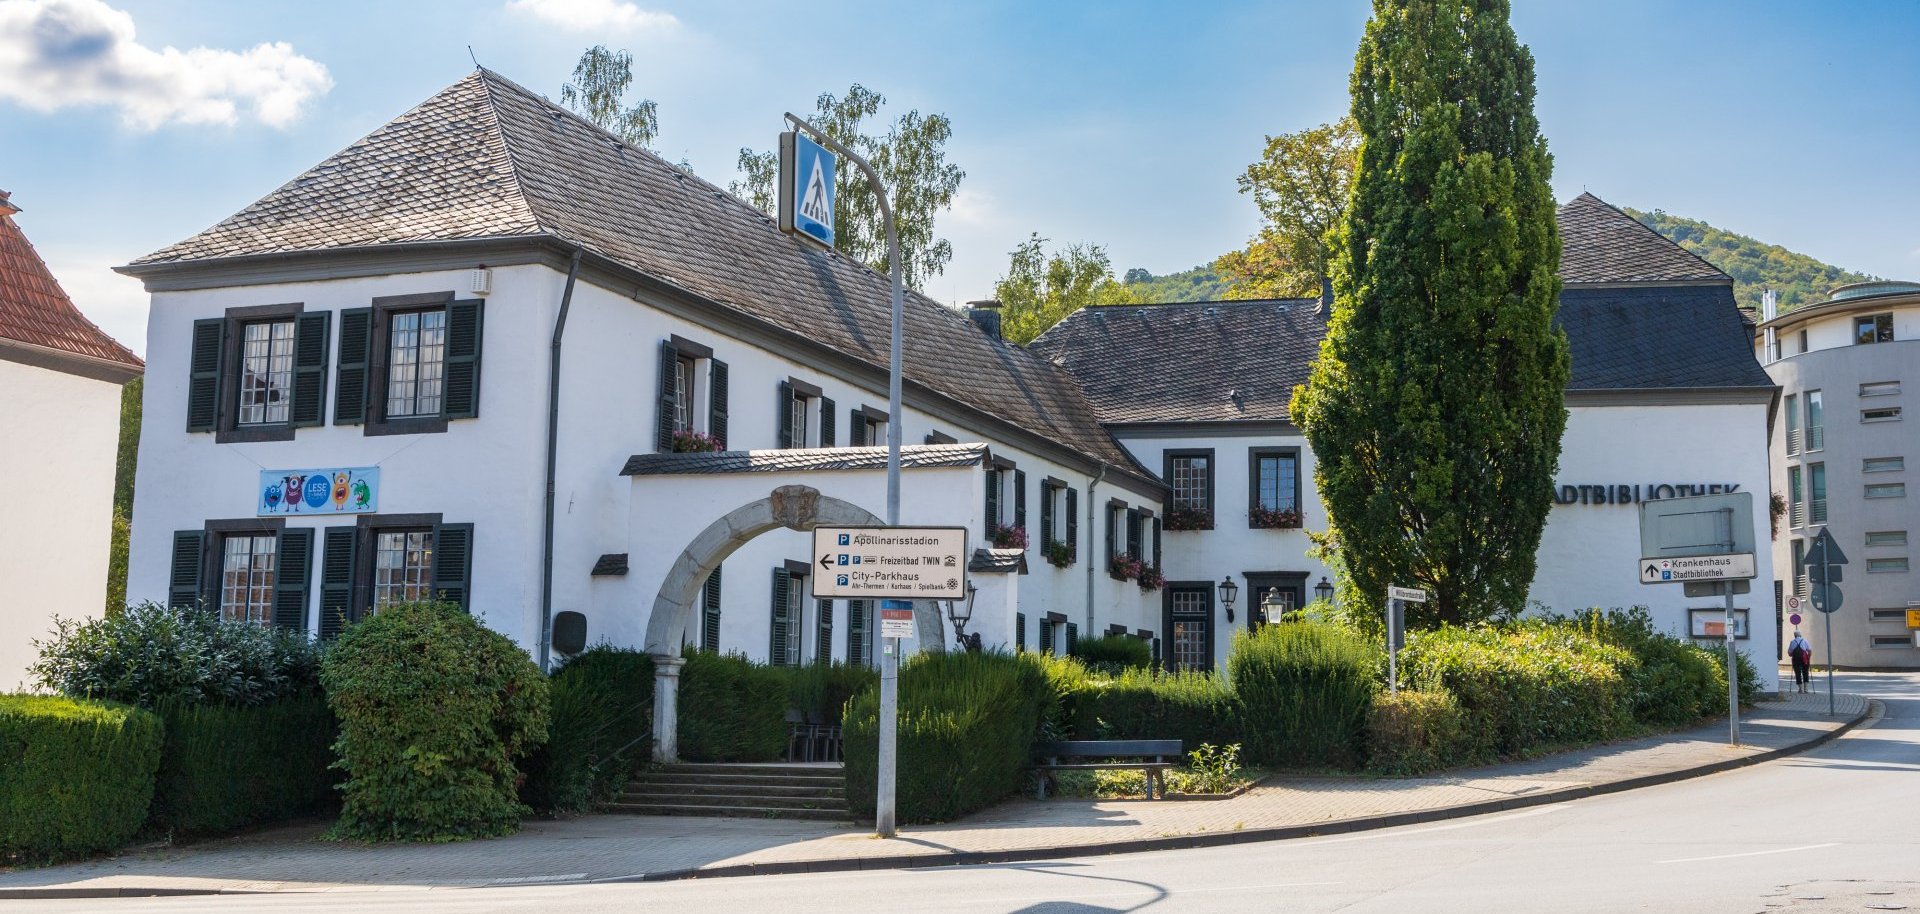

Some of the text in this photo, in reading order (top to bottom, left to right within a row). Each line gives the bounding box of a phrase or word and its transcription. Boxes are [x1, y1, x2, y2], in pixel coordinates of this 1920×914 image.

[308, 483, 327, 492] LESE
[1552, 484, 1740, 505] ADTBIBLIOTHE
[854, 537, 939, 546] Apollinarisstadion
[880, 556, 919, 565] Freizeitbad
[923, 557, 940, 565] TWIN
[1672, 558, 1731, 568] Krankenhaus
[852, 572, 919, 582] City-Parkhaus
[1673, 570, 1724, 579] Stadtbibliothek
